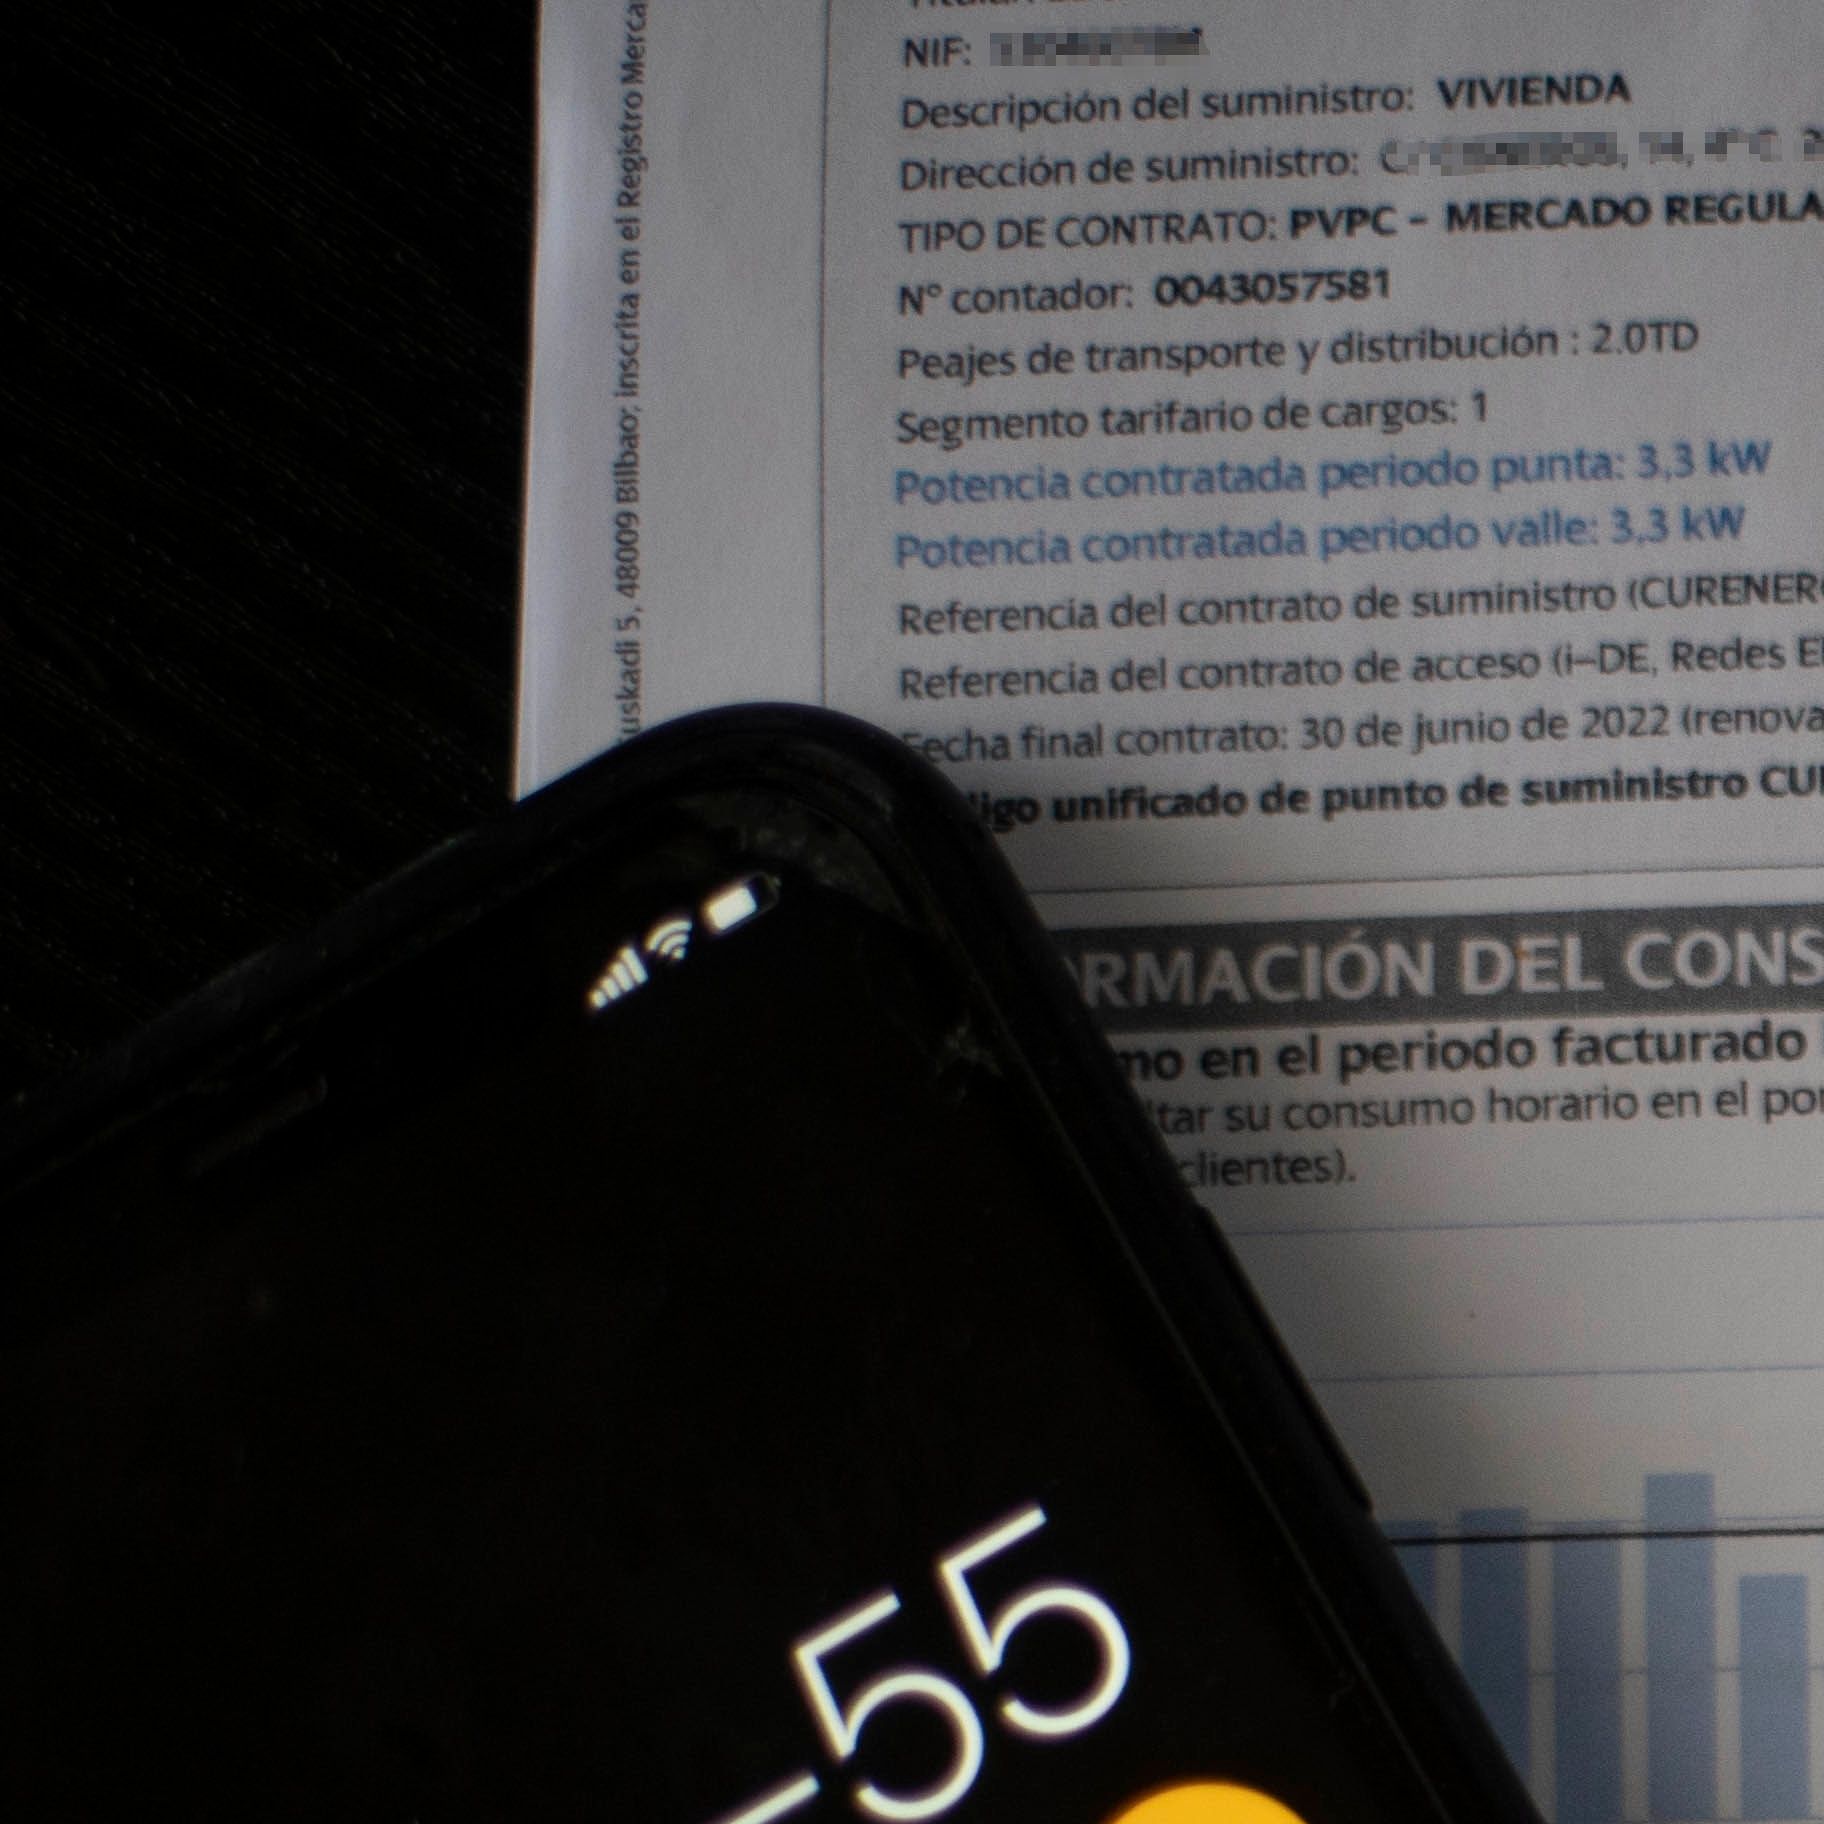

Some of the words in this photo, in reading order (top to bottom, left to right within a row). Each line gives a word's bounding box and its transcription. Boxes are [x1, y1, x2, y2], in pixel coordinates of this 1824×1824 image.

[903, 35, 971, 68] NIF:
[901, 92, 1121, 132] Descripción
[1131, 87, 1190, 121] del
[1201, 84, 1413, 120] suministro:
[1436, 71, 1632, 111] VIVIENDA
[614, 89, 649, 209] Registro
[614, 215, 642, 242] el
[899, 218, 985, 252] TIPO
[996, 216, 1045, 250] DE
[1054, 208, 1275, 248] CONTRATO:
[1288, 204, 1396, 239] PVPC
[1444, 194, 1653, 233] MERCADO
[619, 249, 643, 286] en
[950, 278, 1132, 315] contador:
[1152, 266, 1390, 308] 0043057581
[614, 292, 642, 399] inscrita
[895, 466, 1071, 505] Potencia
[1080, 455, 1307, 500] contratada
[1318, 448, 1480, 499] periodo
[1490, 448, 1624, 493] punta:
[1706, 439, 1772, 477] kW
[614, 511, 643, 600] 48009
[1460, 934, 1604, 995] DEL
[1200, 1046, 1258, 1078] en
[1277, 1033, 1319, 1076] el
[1338, 1027, 1536, 1085] periodo
[1551, 1019, 1807, 1066] facturado
